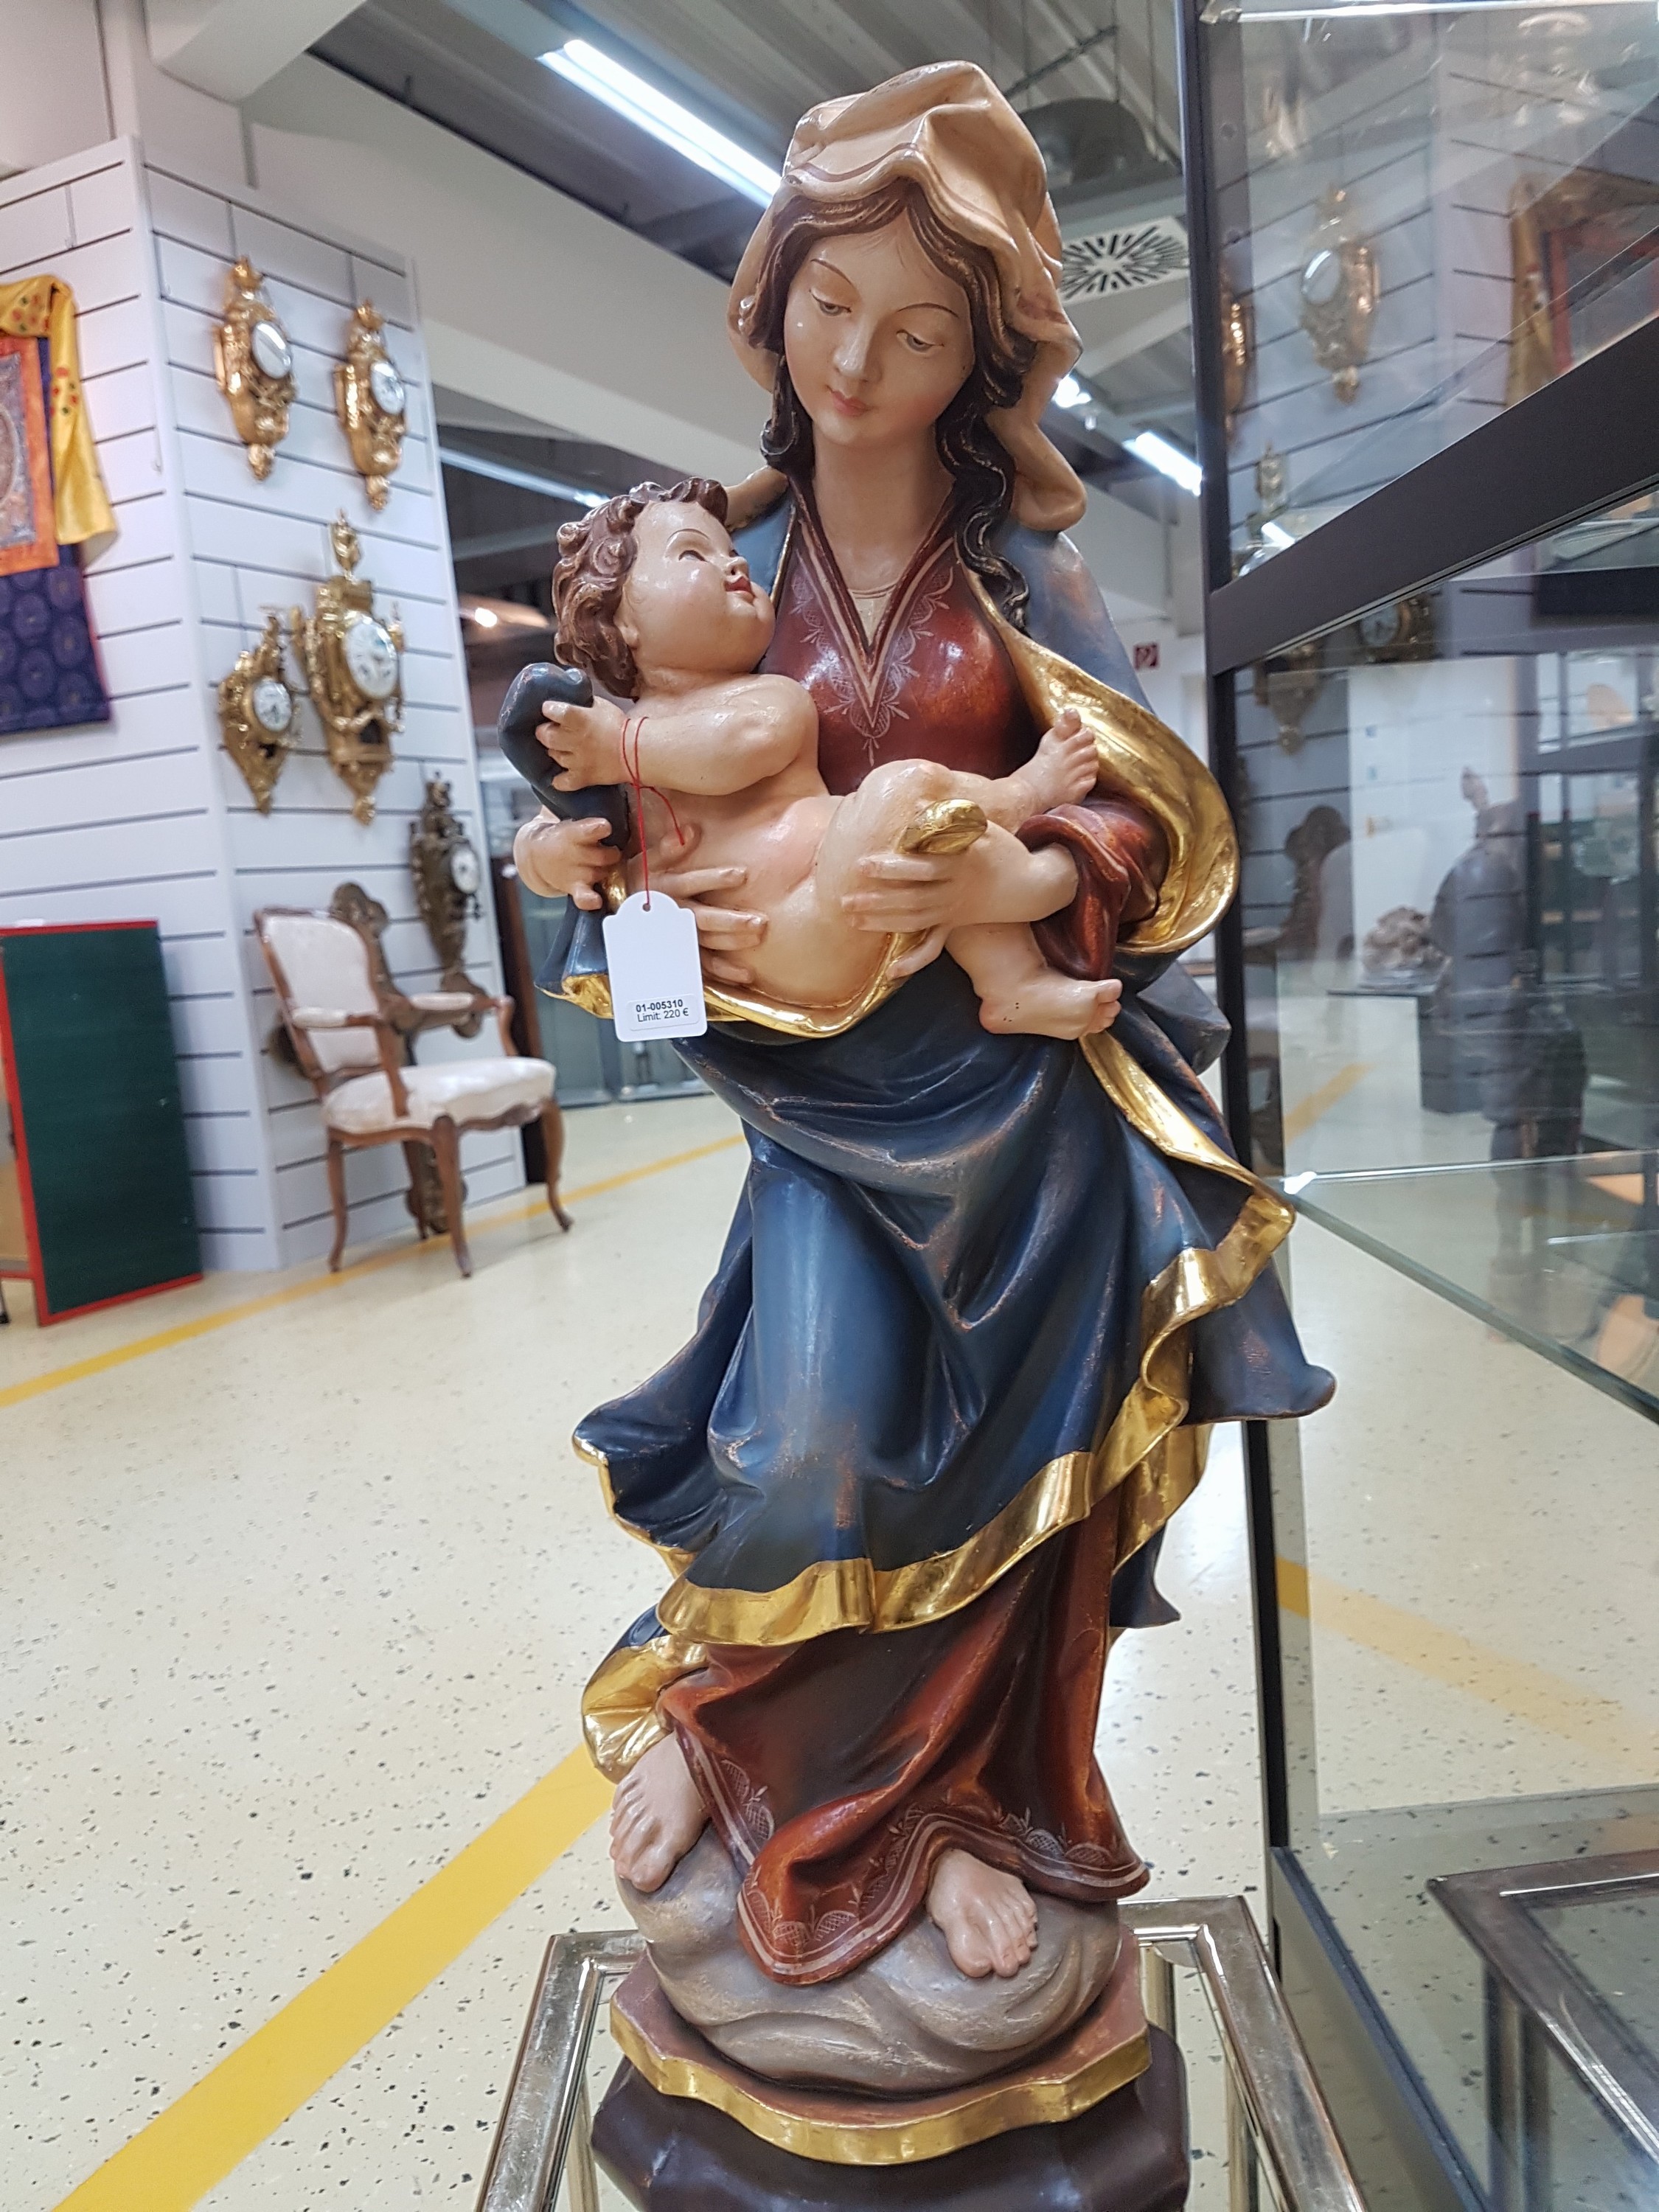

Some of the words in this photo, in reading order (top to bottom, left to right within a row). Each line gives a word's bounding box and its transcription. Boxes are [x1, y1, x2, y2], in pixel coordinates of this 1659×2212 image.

[636, 999, 683, 1012] 01-005310
[637, 1012, 661, 1022] Limit:
[664, 1009, 681, 1019] 220
[683, 1007, 689, 1016] €
